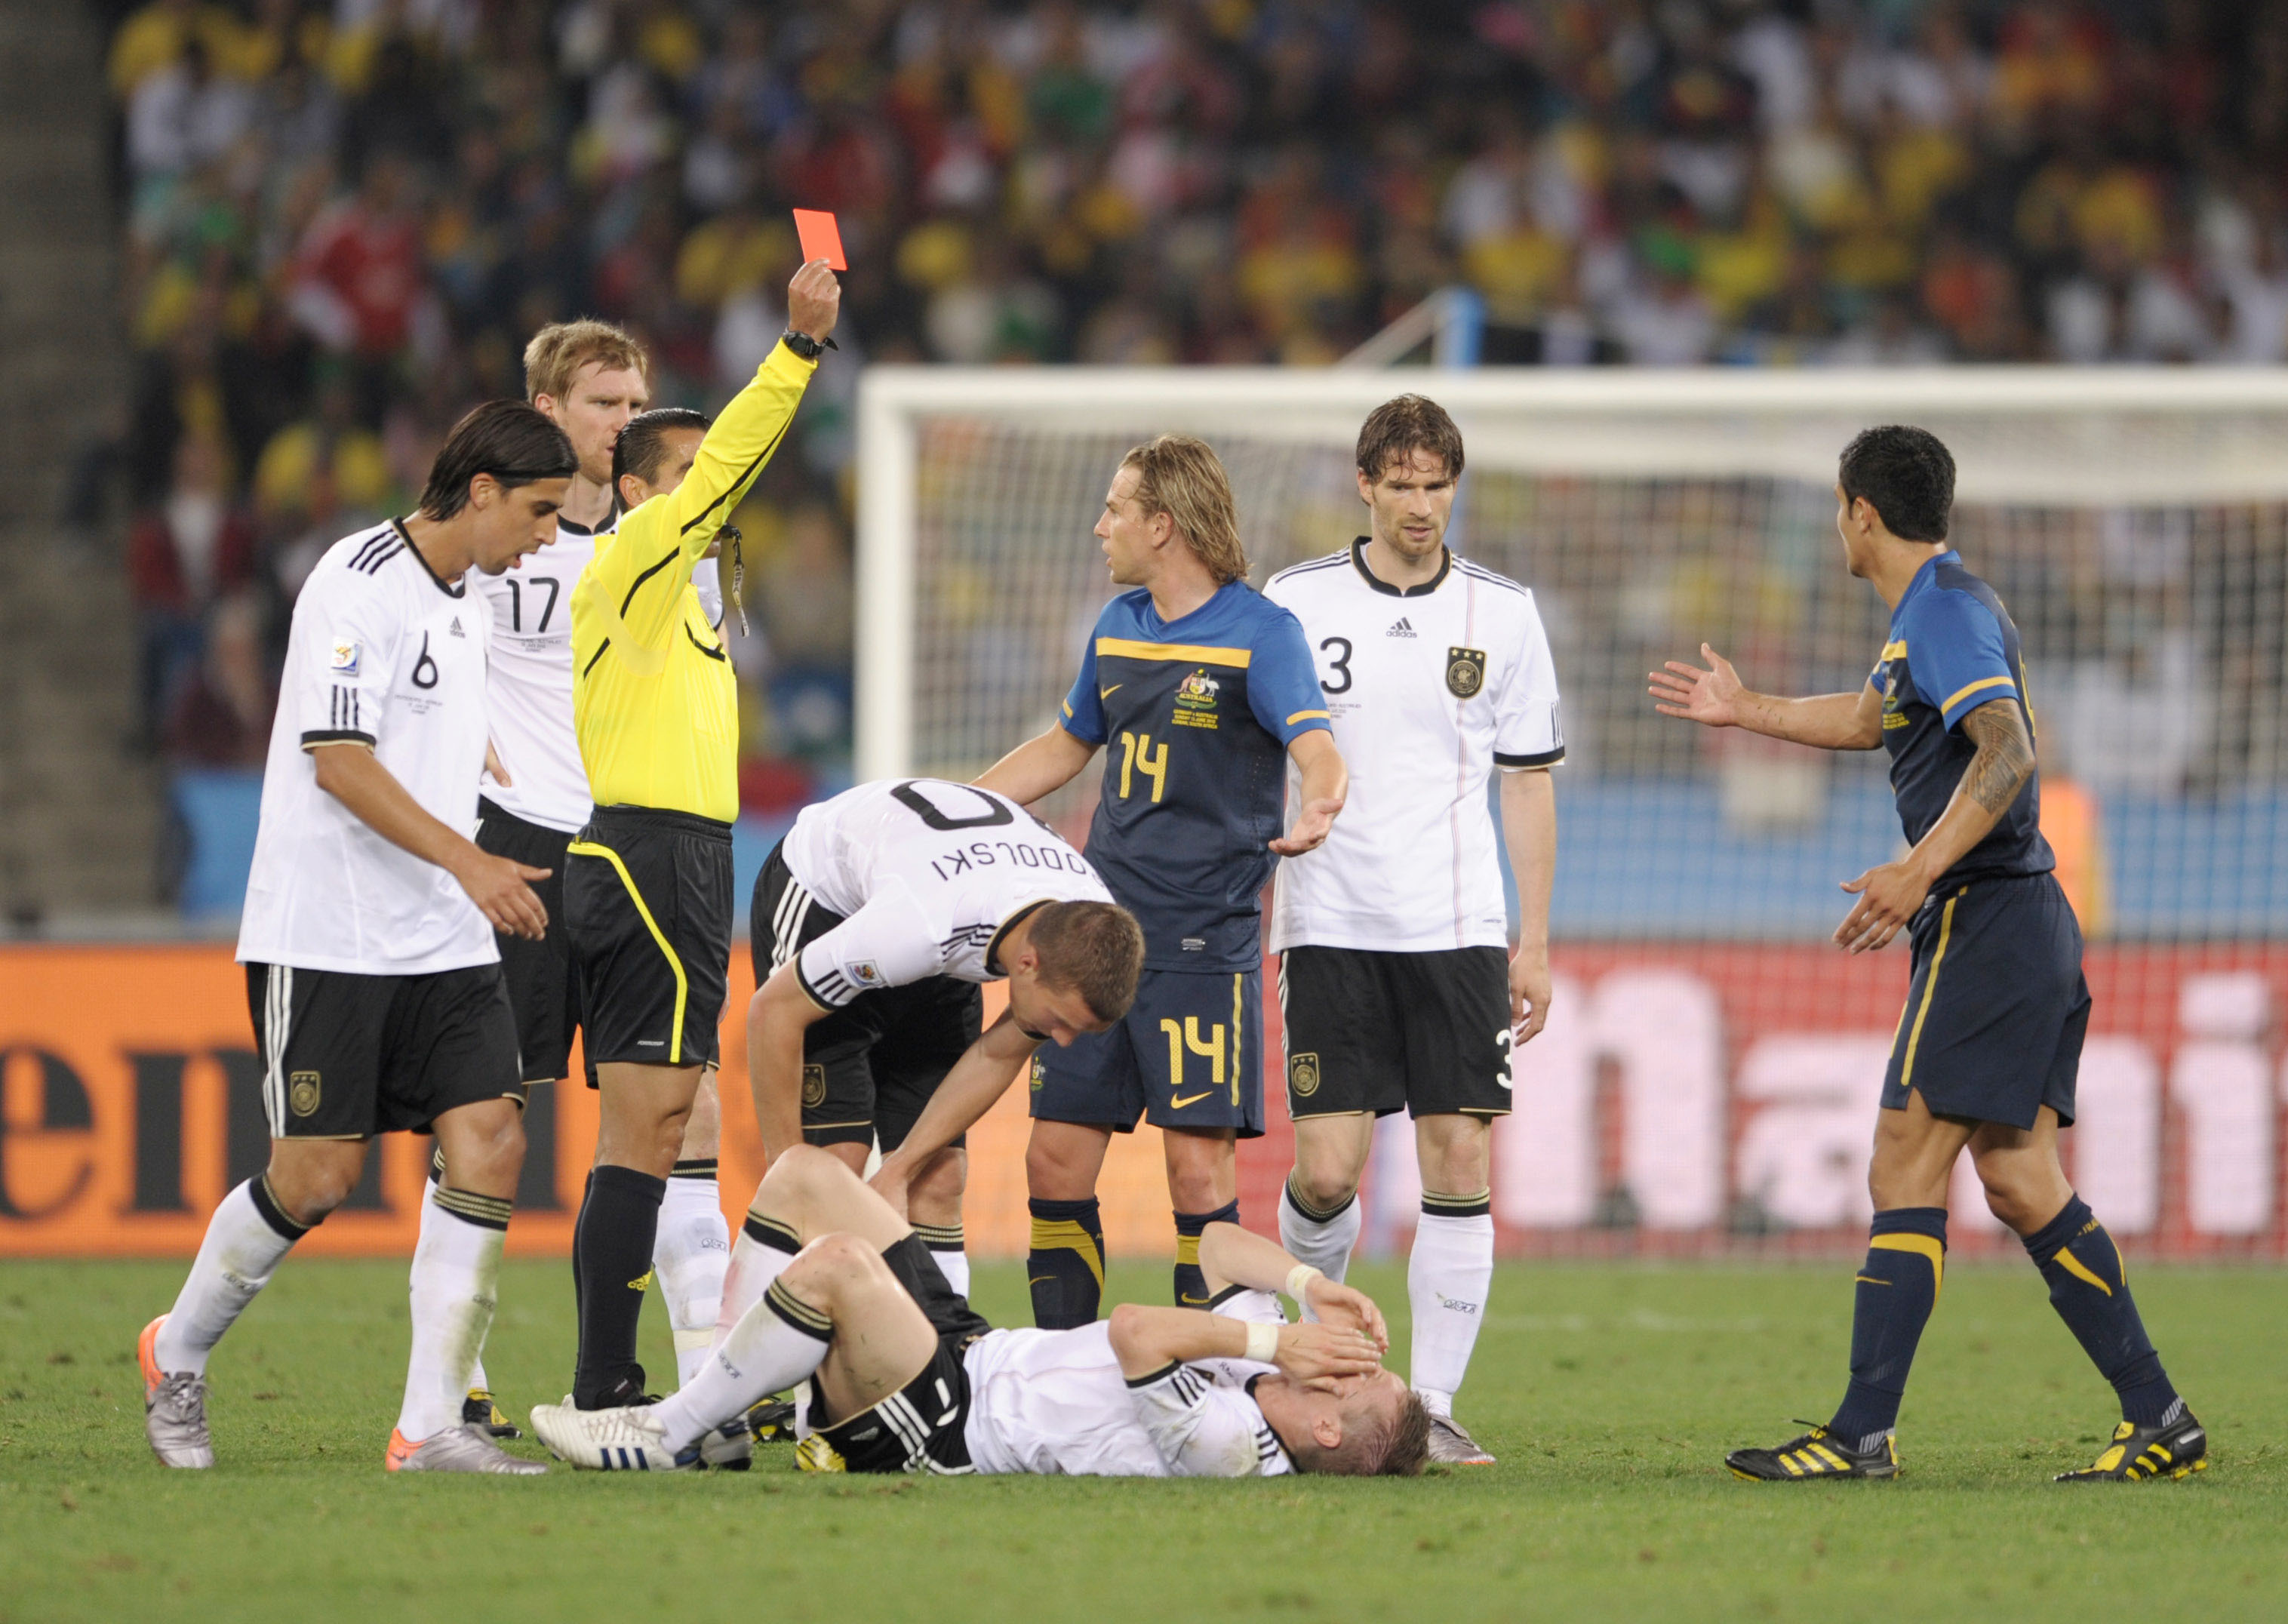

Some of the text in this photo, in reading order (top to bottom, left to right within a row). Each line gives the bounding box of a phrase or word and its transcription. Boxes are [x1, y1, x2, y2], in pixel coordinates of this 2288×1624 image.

[506, 577, 560, 633] 17
[1385, 629, 1418, 638] adidas
[411, 629, 438, 690] 6
[1320, 636, 1352, 695] 3
[1179, 693, 1213, 703] AUSTRALIA
[1119, 731, 1168, 803] 14
[1160, 1016, 1225, 1084] 14
[1496, 1029, 1512, 1090] 3
